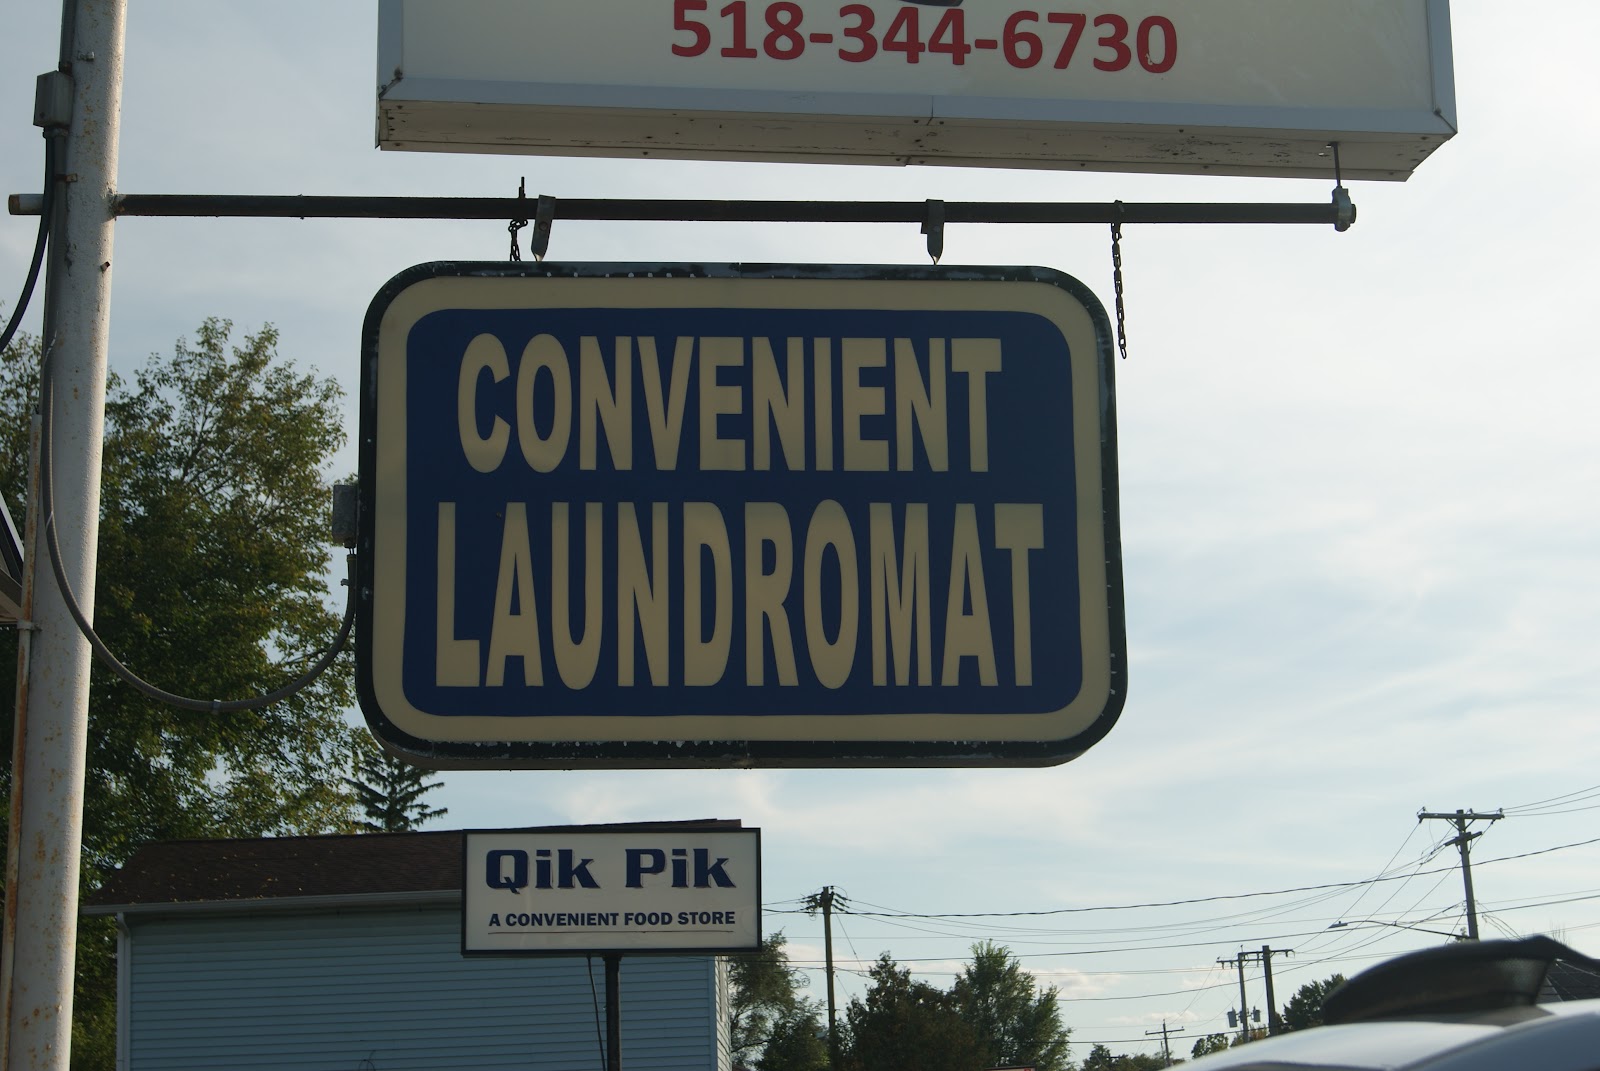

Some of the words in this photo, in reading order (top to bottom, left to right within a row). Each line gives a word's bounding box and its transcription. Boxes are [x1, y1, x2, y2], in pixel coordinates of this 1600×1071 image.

[672, 0, 1177, 73] 518-344-6730
[458, 333, 1002, 473] CONVENIENT
[436, 500, 1044, 690] LAUNDROMAT
[486, 849, 600, 894] Qik
[625, 848, 736, 888] Pik
[489, 913, 500, 927] A
[505, 912, 619, 927] CONVENIENT
[624, 912, 673, 926] FOOD
[677, 911, 736, 926] STORE
